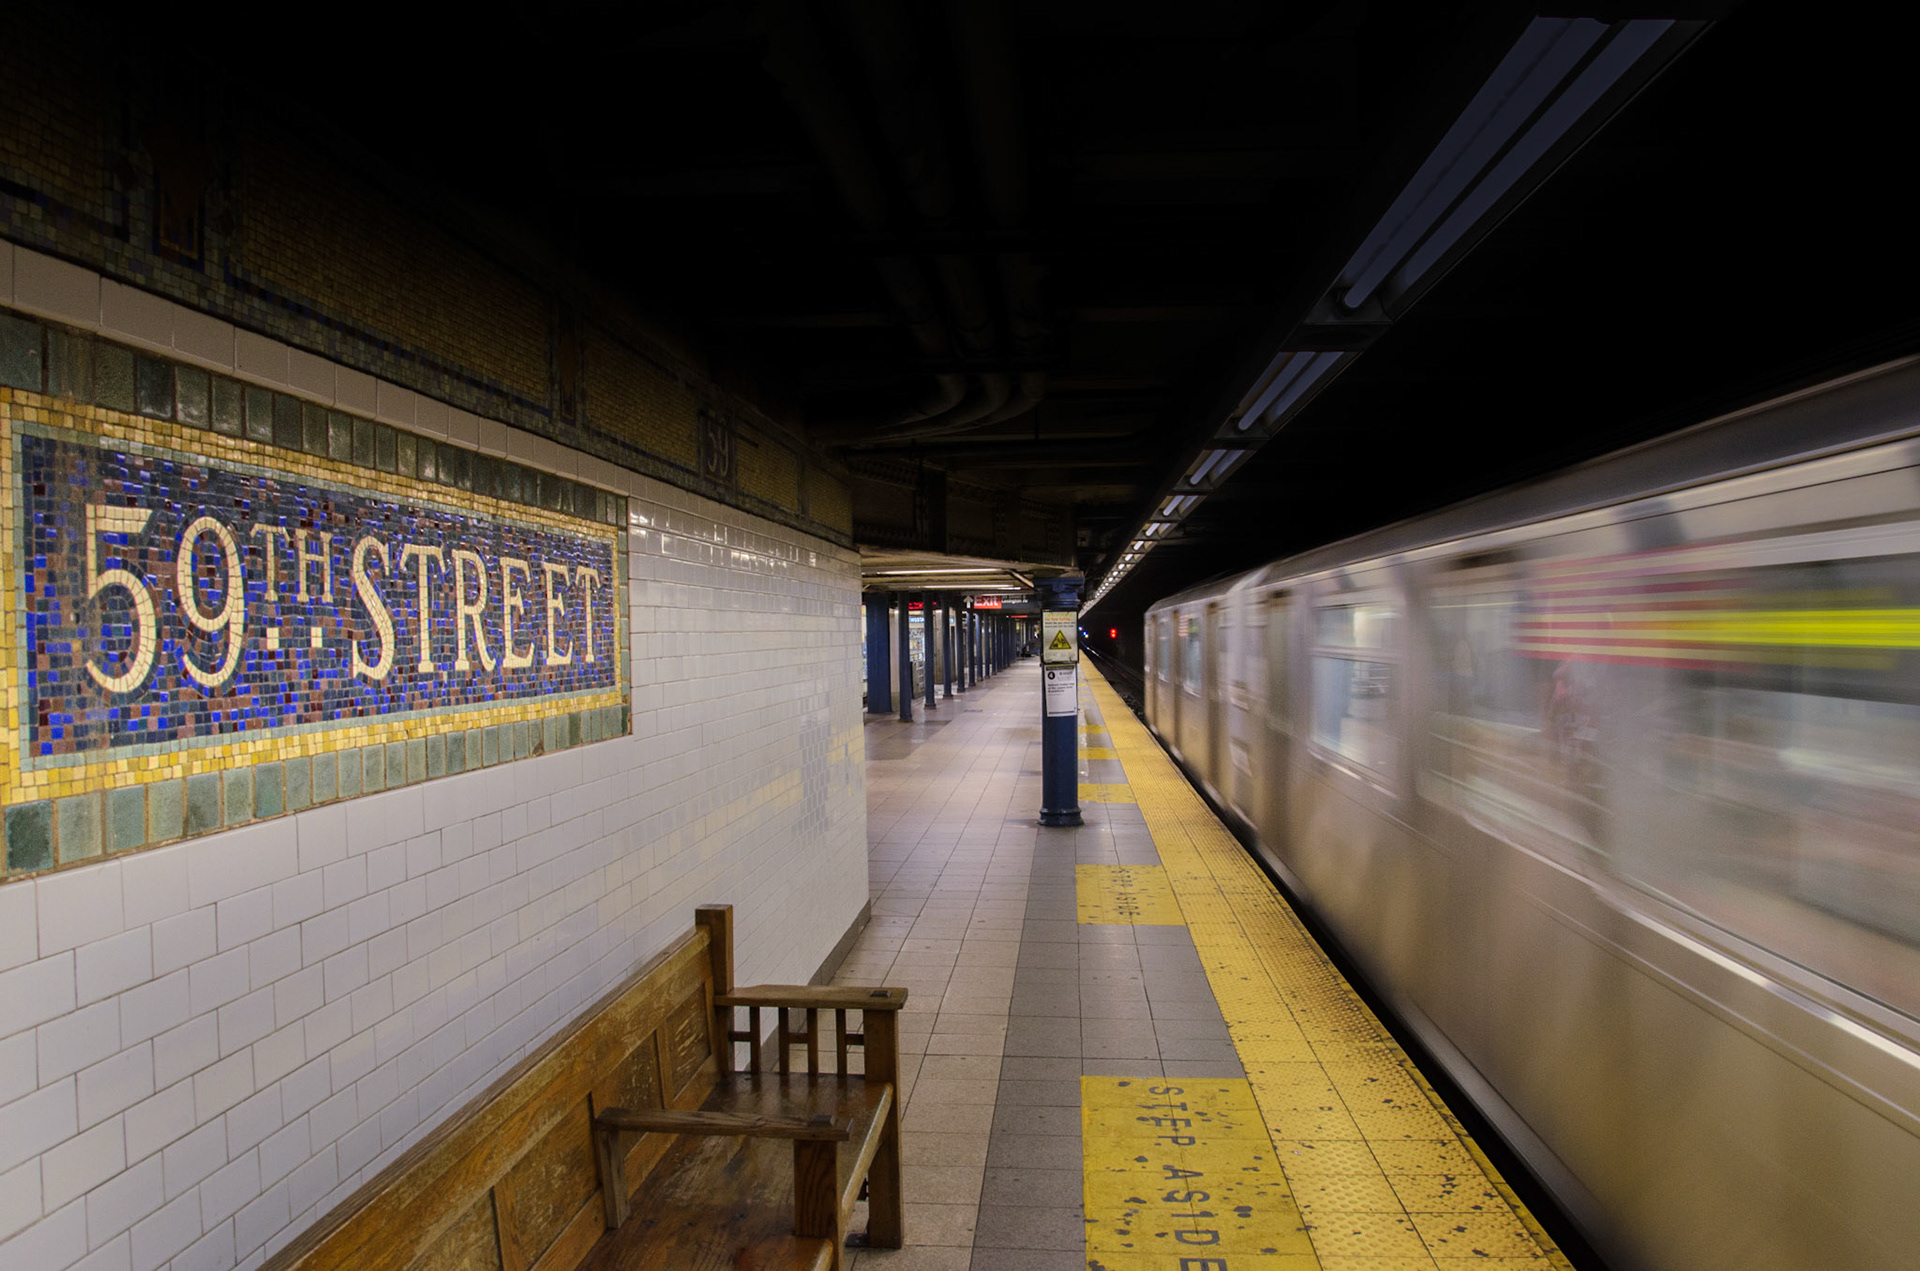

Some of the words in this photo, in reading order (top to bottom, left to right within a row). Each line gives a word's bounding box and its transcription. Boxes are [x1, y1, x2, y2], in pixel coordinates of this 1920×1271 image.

[351, 533, 601, 681] STREET
[973, 595, 999, 606] Exit
[1148, 1086, 1196, 1147] STEP
[1162, 1164, 1228, 1271] ASIDE
